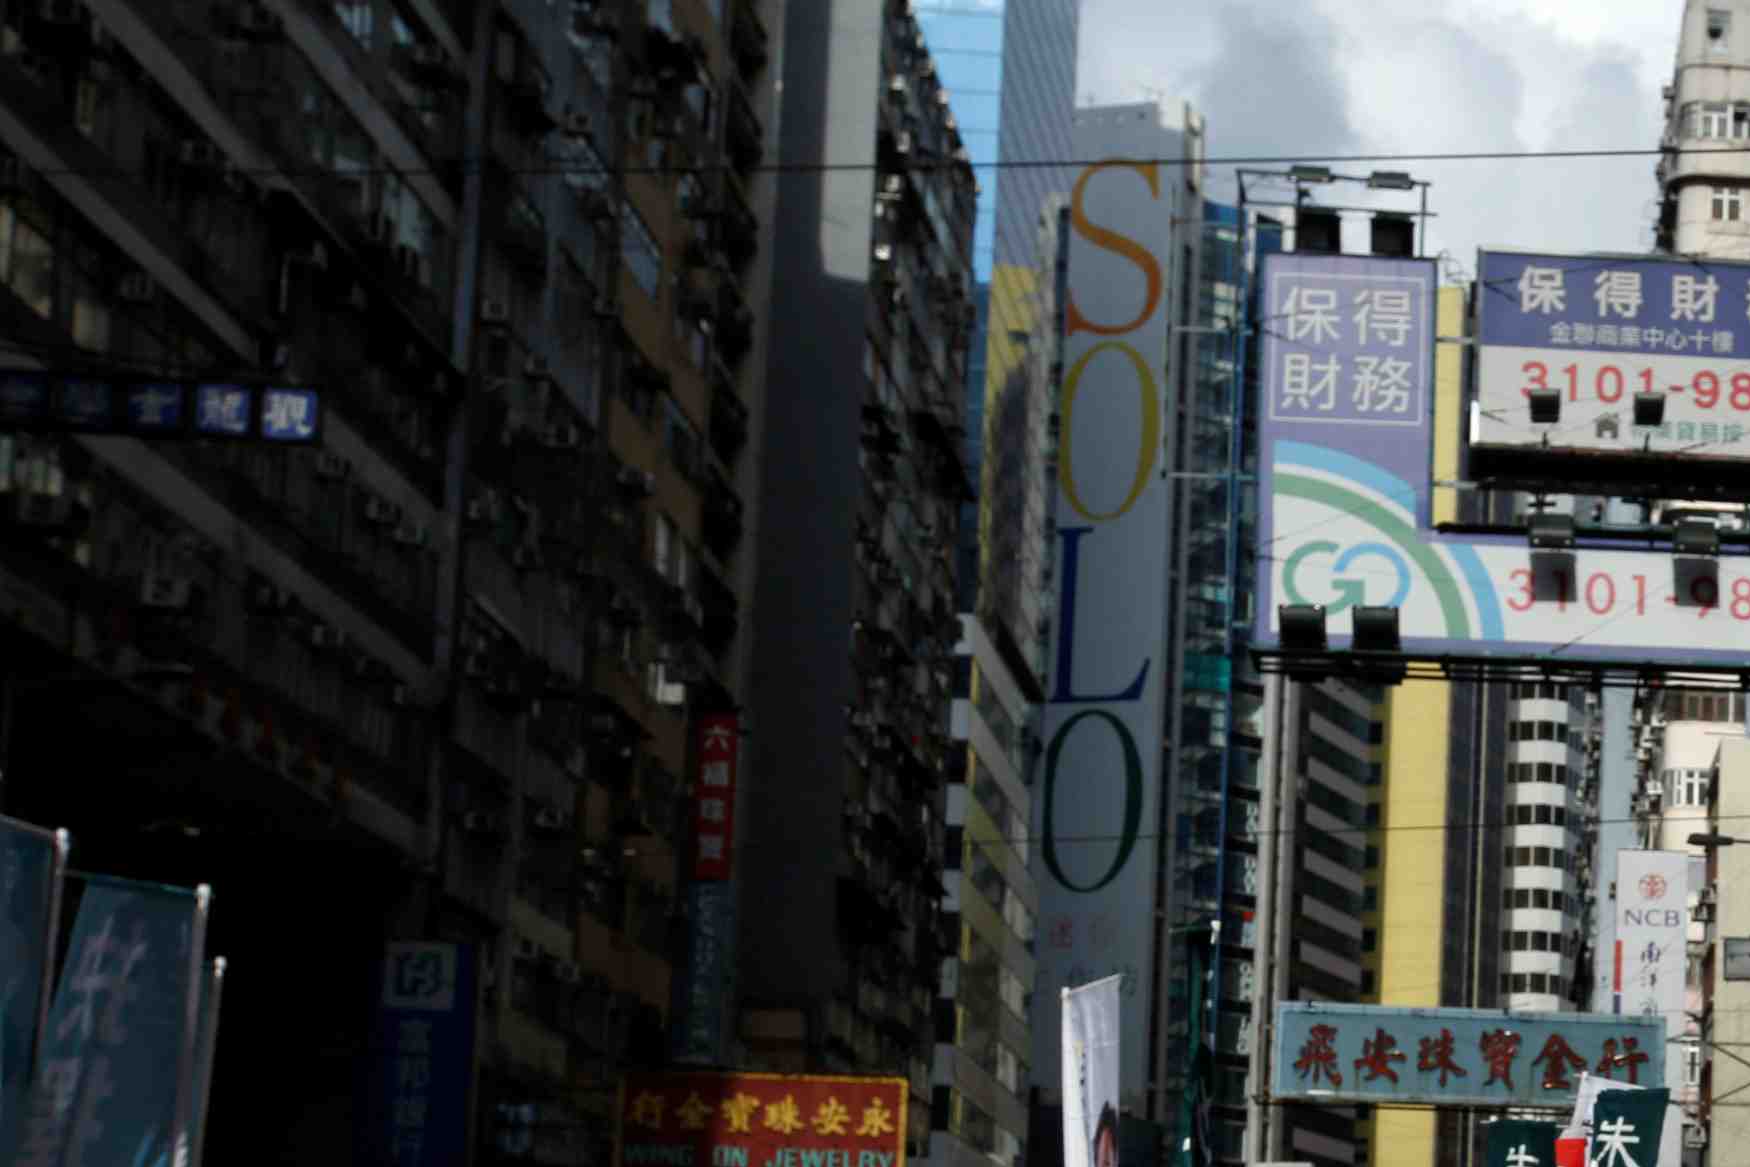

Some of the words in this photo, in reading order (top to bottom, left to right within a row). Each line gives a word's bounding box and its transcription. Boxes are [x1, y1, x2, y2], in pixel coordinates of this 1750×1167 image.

[1281, 287, 1414, 348] 保得
[1281, 355, 1413, 413] 財務
[1041, 159, 1162, 894] SOLO
[1624, 908, 1681, 927] NCB
